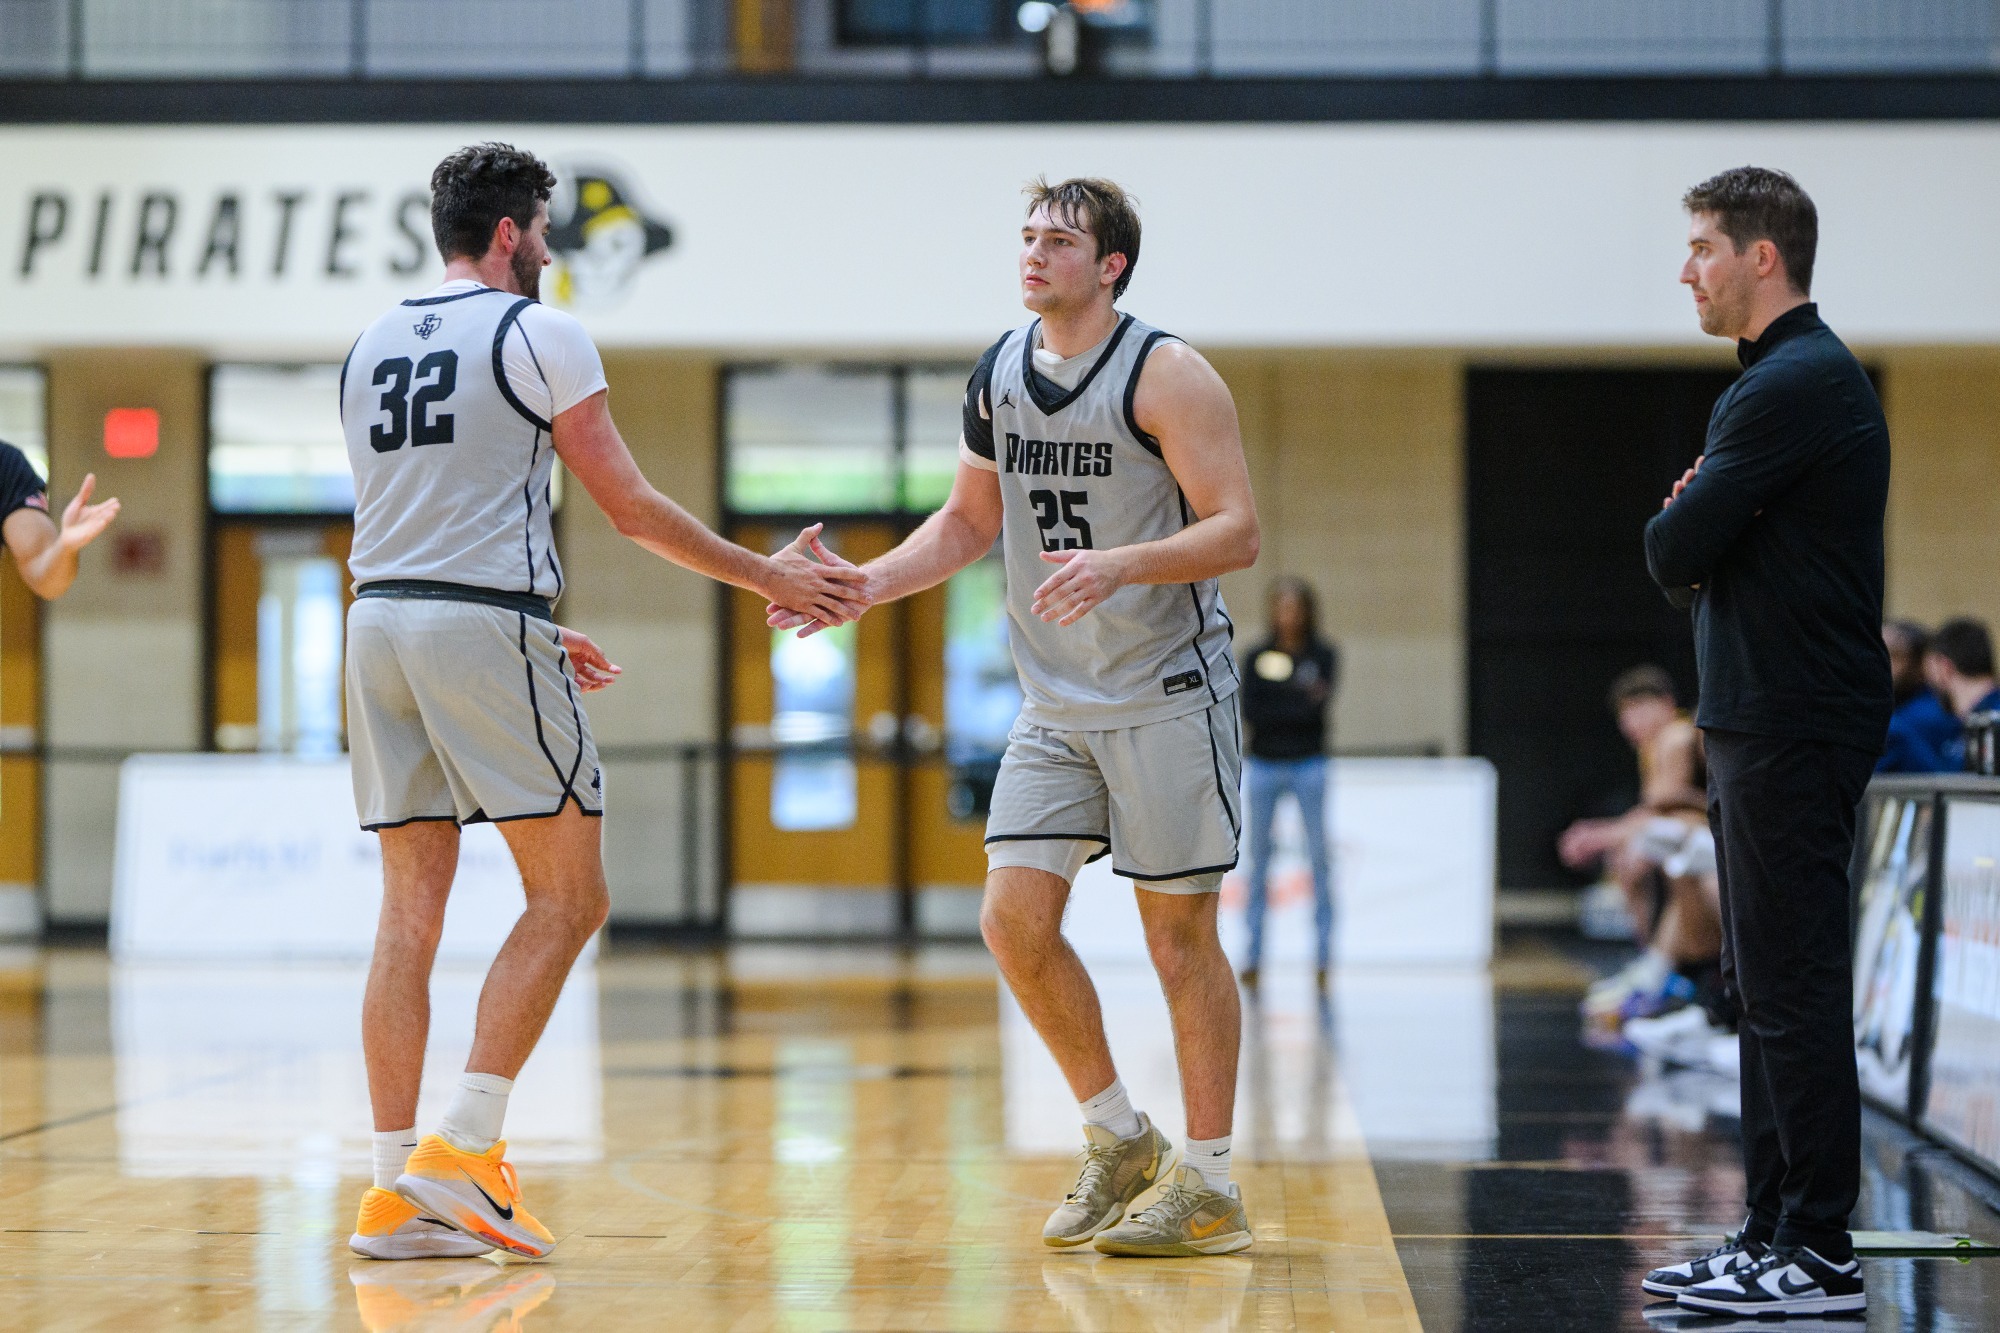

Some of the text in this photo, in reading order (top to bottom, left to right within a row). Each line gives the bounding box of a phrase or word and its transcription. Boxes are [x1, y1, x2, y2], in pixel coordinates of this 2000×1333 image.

[17, 190, 432, 279] PIRATES
[370, 349, 459, 454] 32
[1005, 432, 1113, 477] PIRATES
[1029, 489, 1093, 552] 25
[1188, 675, 1200, 683] XL
